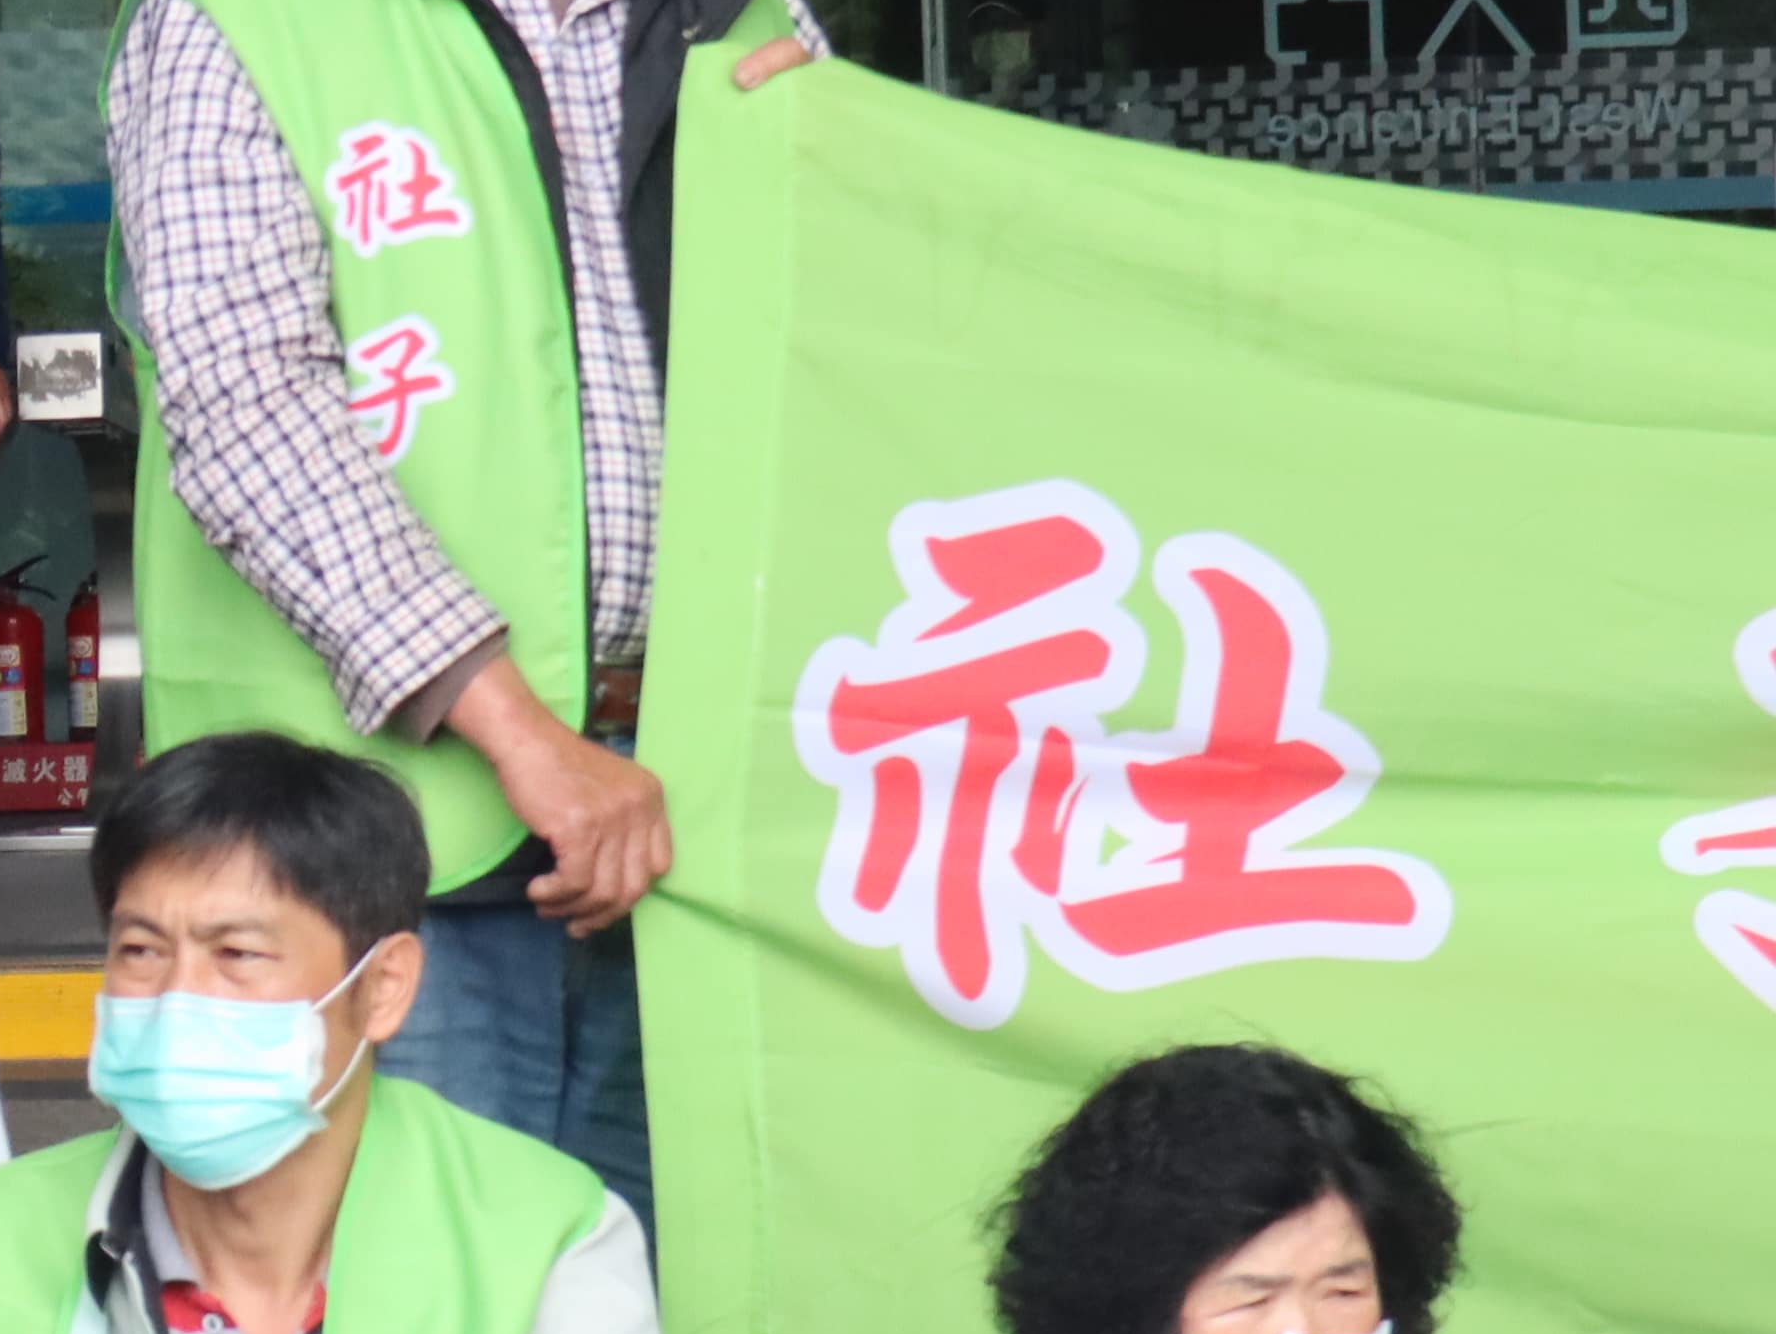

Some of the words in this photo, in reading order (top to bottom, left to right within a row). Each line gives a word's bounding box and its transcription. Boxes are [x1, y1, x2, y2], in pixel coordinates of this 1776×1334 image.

[2, 755, 90, 784] 滅火器
[793, 477, 1776, 1029] 社
